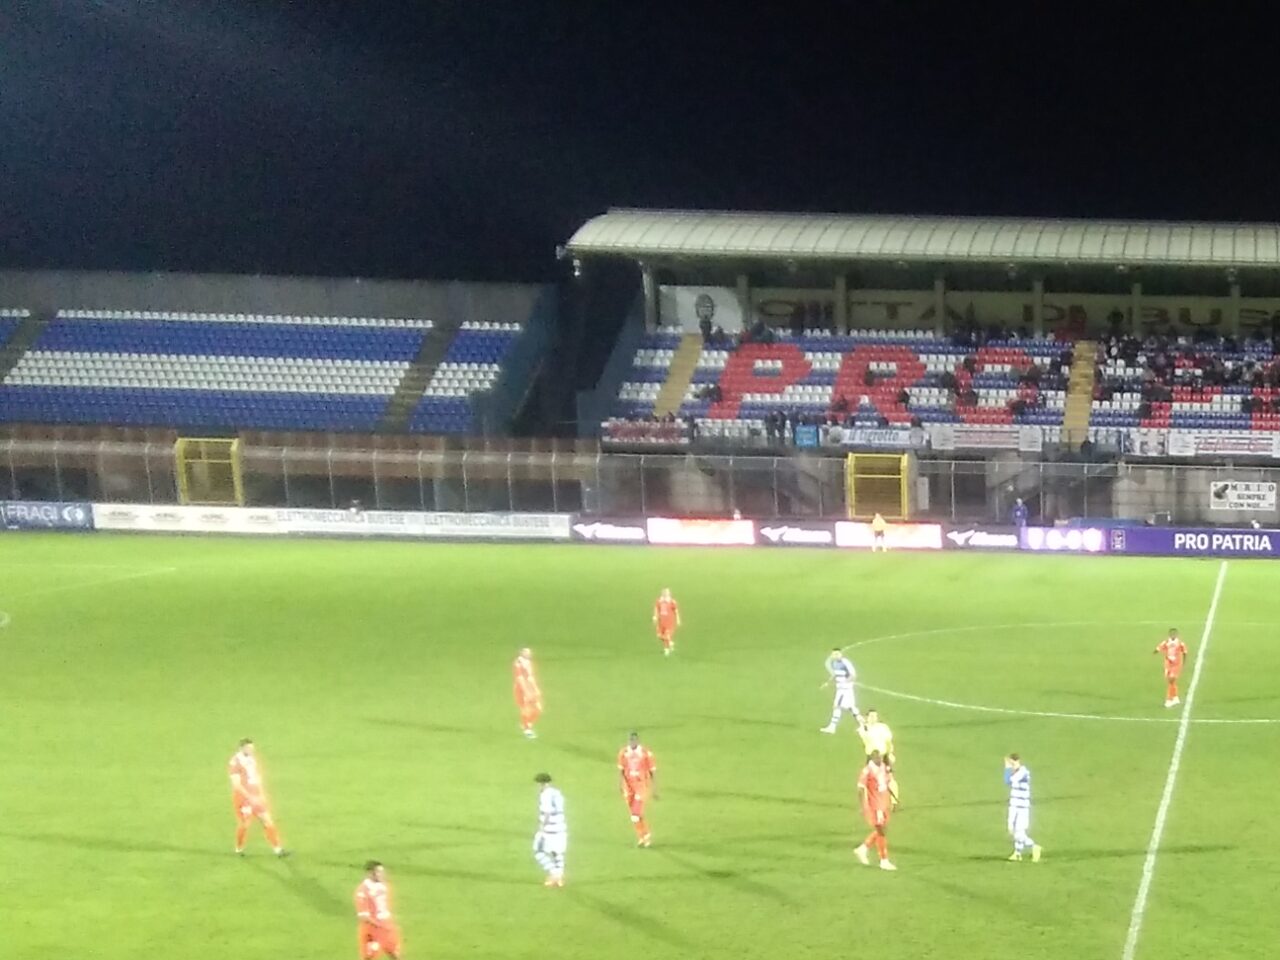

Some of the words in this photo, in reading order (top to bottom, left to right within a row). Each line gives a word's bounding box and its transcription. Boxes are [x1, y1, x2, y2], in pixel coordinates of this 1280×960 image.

[6, 505, 58, 520] FRAGI
[1174, 533, 1206, 549] PRO
[1212, 534, 1272, 550] PATRIA
